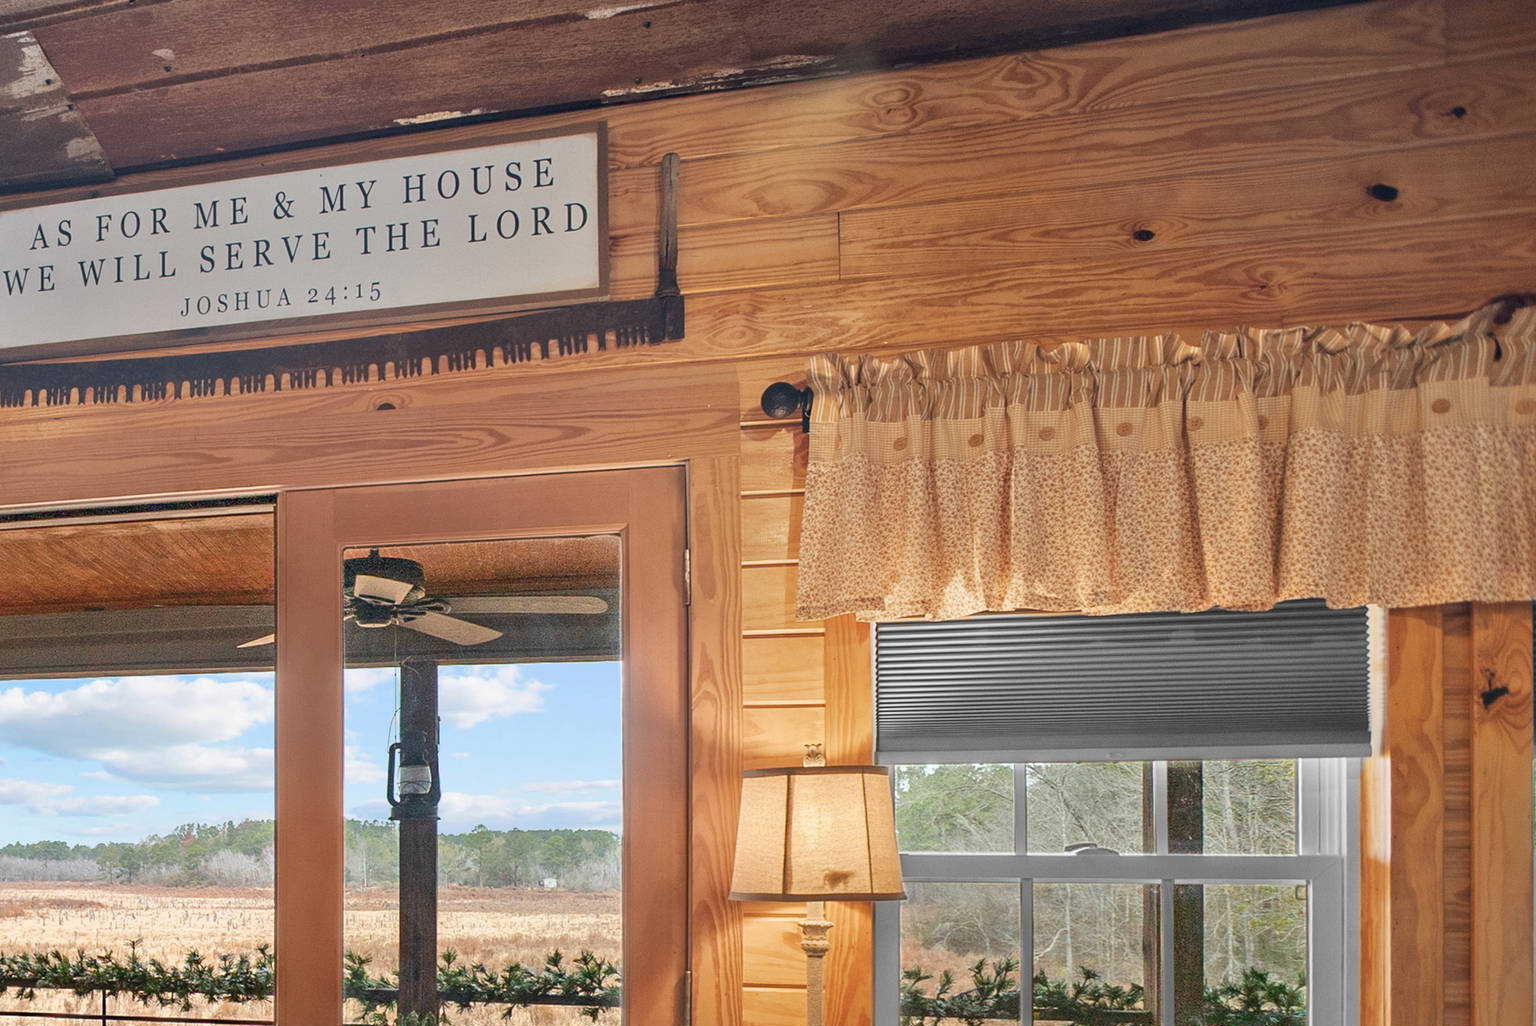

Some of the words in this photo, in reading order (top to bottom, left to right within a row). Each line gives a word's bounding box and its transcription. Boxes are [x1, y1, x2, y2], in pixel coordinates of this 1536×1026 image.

[3, 264, 56, 296] WE
[77, 250, 176, 287] WILL
[199, 231, 331, 274] SERVE
[355, 218, 441, 255] THE
[467, 202, 588, 243] LORD
[29, 219, 73, 251] AS
[95, 207, 171, 242] FOR
[193, 196, 249, 230] ME
[273, 191, 295, 220] &
[319, 179, 377, 215] MY
[402, 157, 554, 204] HOUSE
[180, 287, 292, 317] JOSHUA
[307, 281, 381, 305] 24:15
